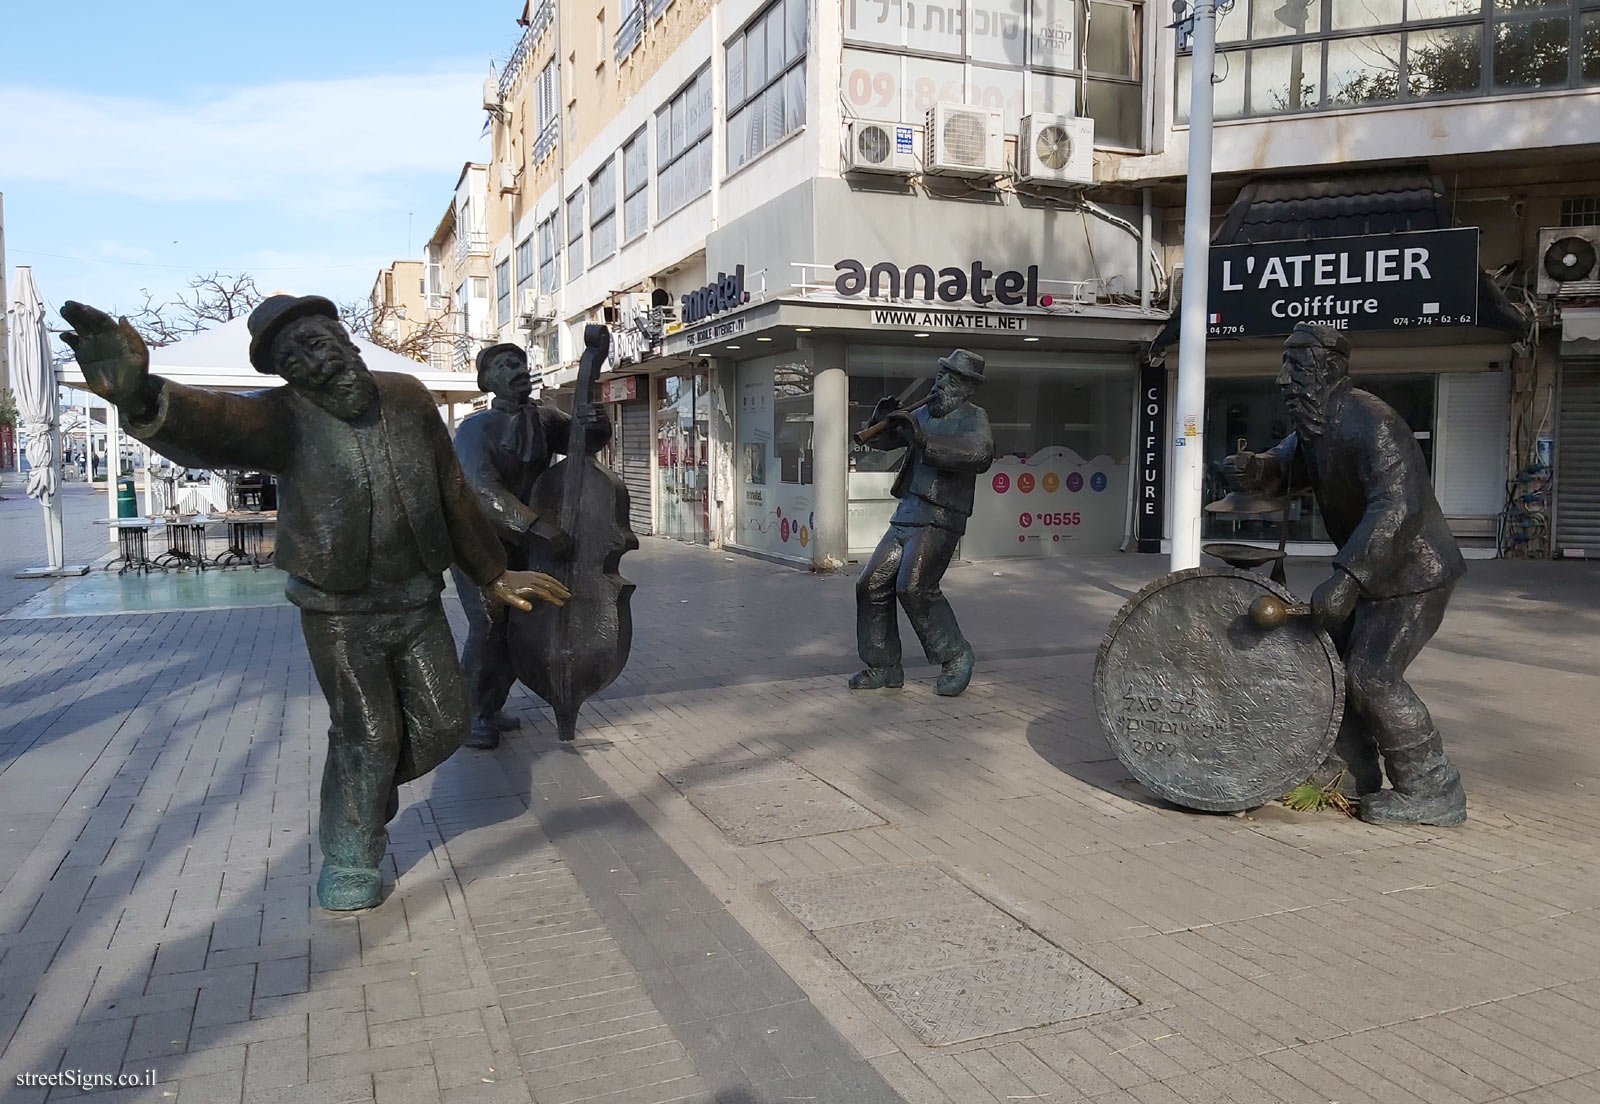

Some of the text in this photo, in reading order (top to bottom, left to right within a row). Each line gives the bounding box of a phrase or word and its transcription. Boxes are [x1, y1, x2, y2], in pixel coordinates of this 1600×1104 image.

[1222, 247, 1432, 291] L'ATELIER
[1271, 295, 1379, 319] Coiffure
[738, 317, 746, 331] TV
[875, 310, 1026, 331] WWW.ANNATEL.NET
[1393, 317, 1409, 326] 074
[1417, 316, 1432, 325] 714
[1441, 315, 1452, 324] 62
[1460, 314, 1471, 323] 62
[1145, 388, 1159, 515] COIFFURE
[1132, 739, 1178, 757] 2007
